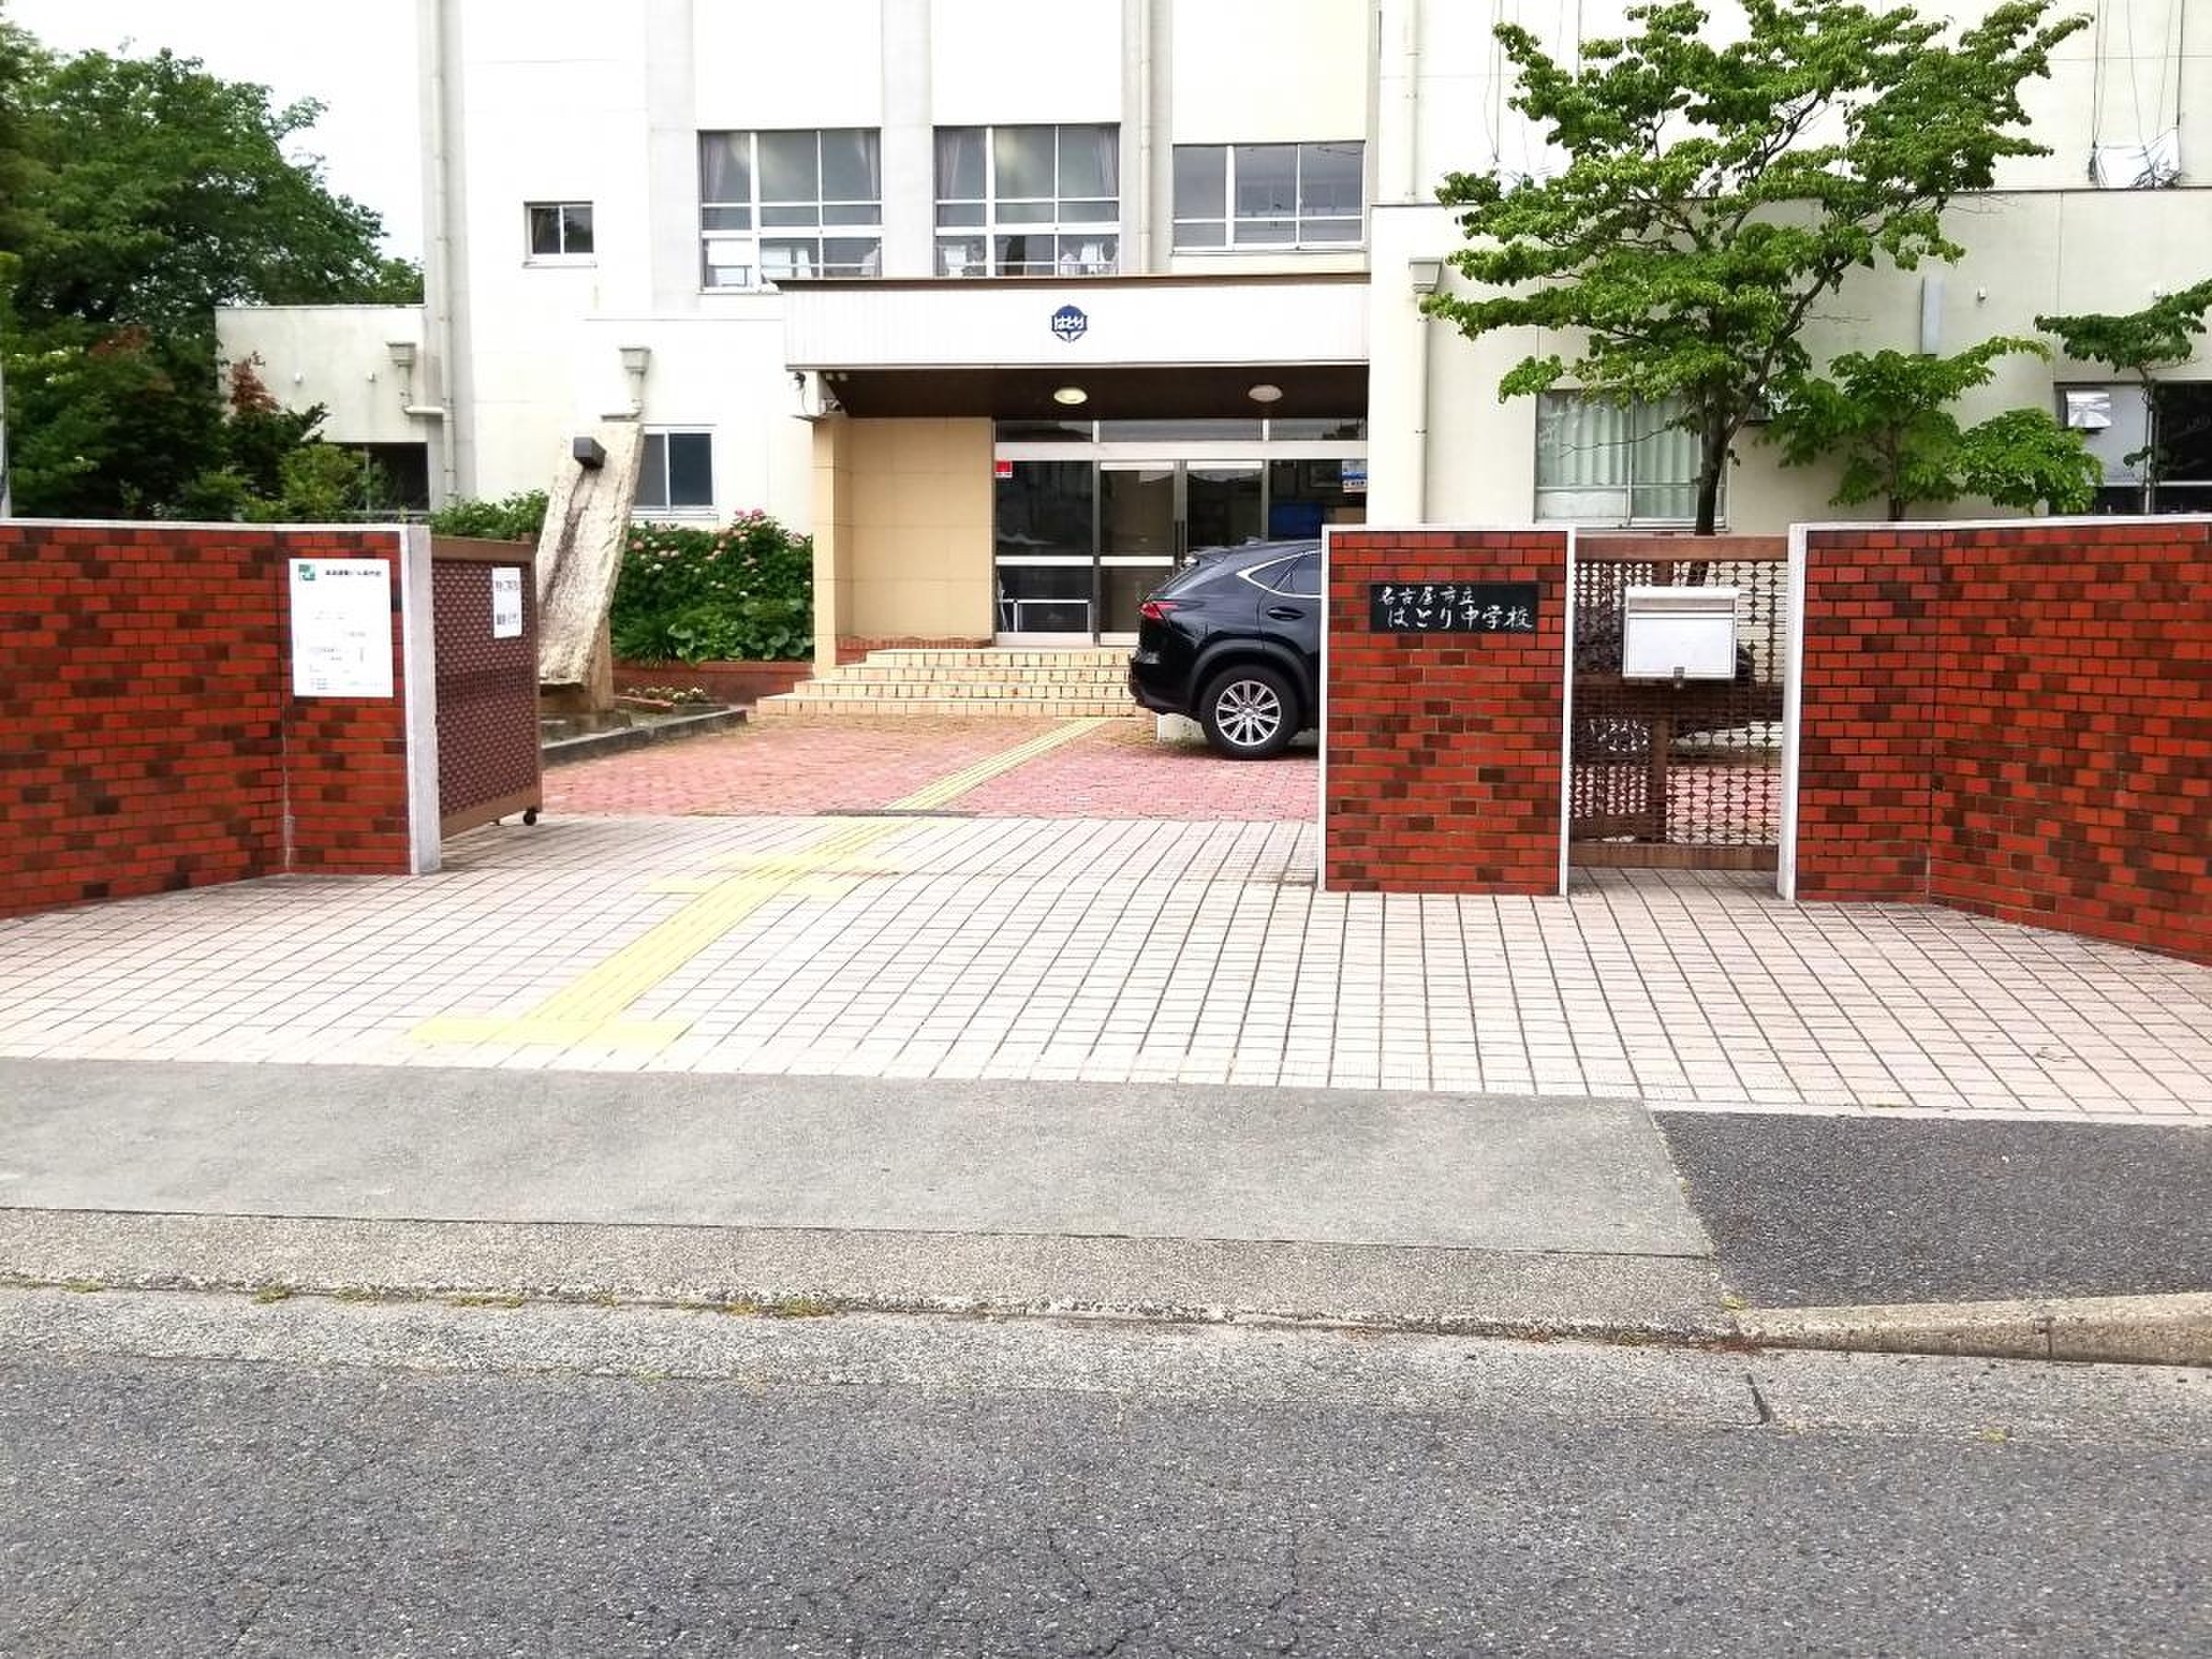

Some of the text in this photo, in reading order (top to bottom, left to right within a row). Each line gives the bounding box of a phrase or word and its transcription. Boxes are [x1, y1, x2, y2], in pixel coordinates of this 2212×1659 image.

[1381, 586, 1475, 606] 名古屋市立
[1386, 605, 1533, 629] はとり中学校
